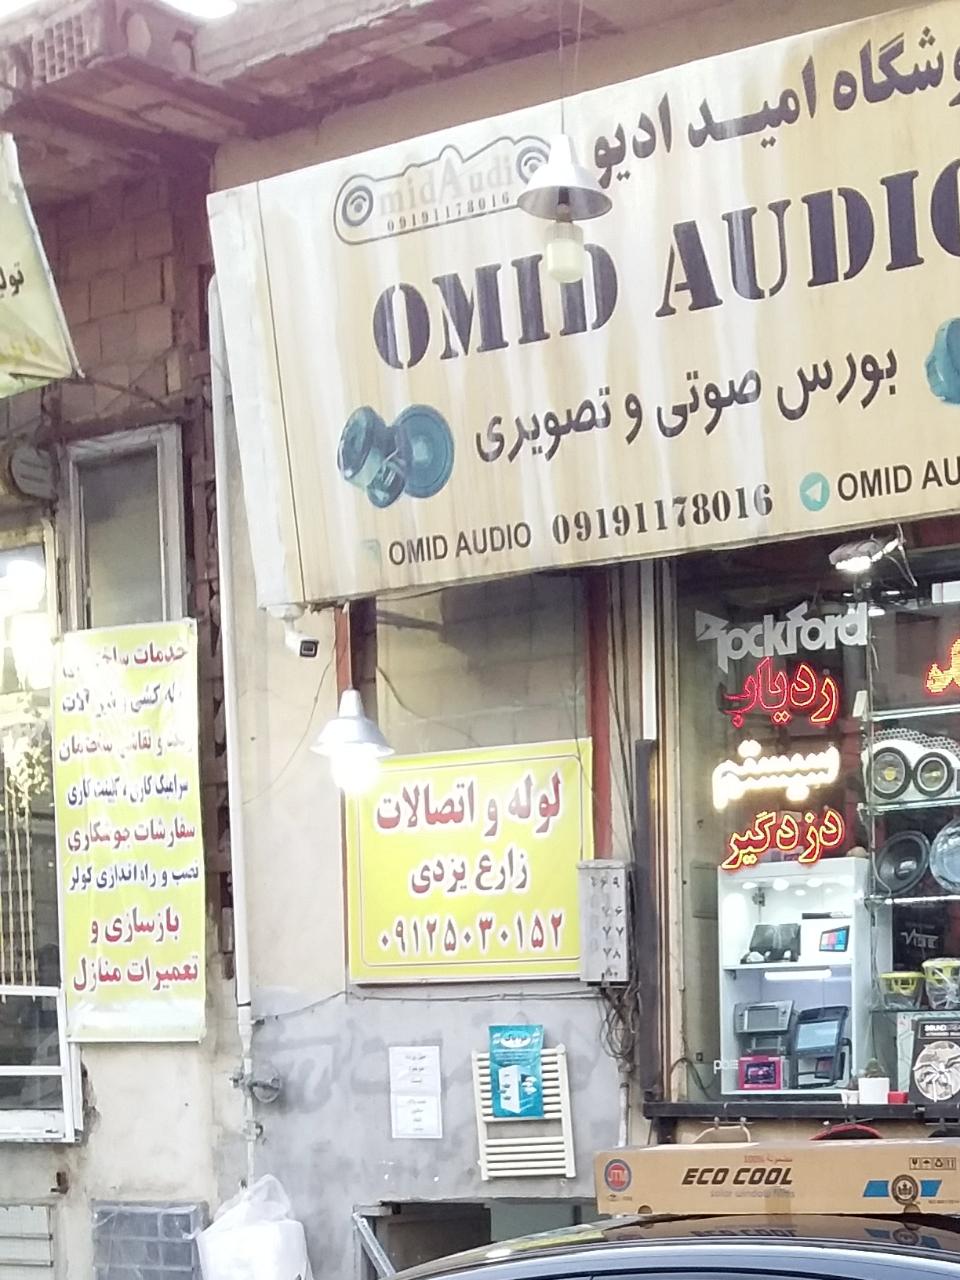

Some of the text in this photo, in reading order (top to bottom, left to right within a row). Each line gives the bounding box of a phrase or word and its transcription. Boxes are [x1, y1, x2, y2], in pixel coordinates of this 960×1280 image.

[688, 55, 817, 149] امید
[593, 92, 673, 189] ادیو
[386, 194, 510, 232] 09191178016
[372, 242, 619, 370] OMID
[475, 347, 898, 462] بورس صوتی و تصویری
[838, 464, 913, 502] OMID
[388, 482, 774, 566] OMID AUDIO 09191178016
[722, 655, 838, 729] ردیاب
[376, 772, 562, 837] لوله و اتصالات
[133, 816, 196, 848] سفارشات
[721, 810, 844, 870] دزدگیر
[411, 847, 528, 894] زارع یزدی
[90, 906, 180, 944] بازسازی و
[380, 911, 563, 953] ۰۹۱۲۵۰۳۰۱۵۲
[73, 955, 199, 992] تعمیرات منازل
[681, 1167, 793, 1185] ECO COOL
